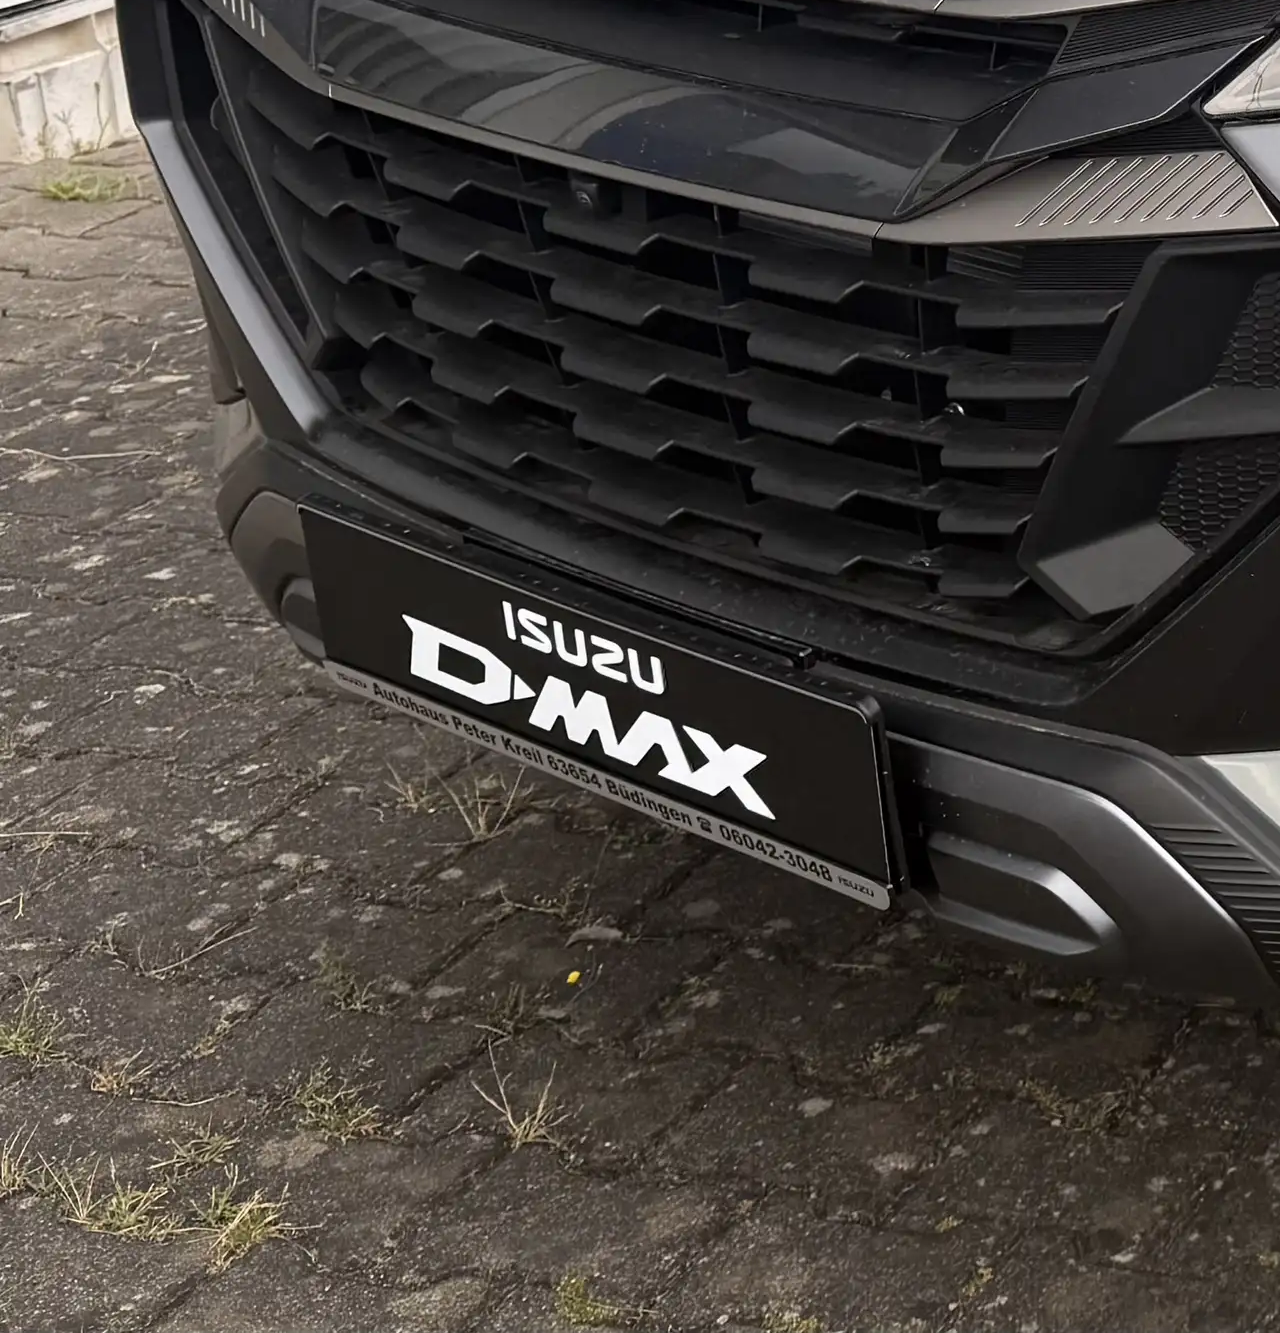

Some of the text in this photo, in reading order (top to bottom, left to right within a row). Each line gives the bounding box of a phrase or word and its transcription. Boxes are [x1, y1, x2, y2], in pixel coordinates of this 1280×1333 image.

[502, 601, 667, 695] ISUZU
[373, 682, 449, 725] Autohaus
[452, 715, 498, 745] Peter
[501, 734, 544, 764] Kreil
[547, 755, 602, 788] 63654
[606, 779, 693, 826] Büdingen
[719, 824, 833, 882] 06042-3048
[838, 876, 875, 898] ISUZU
